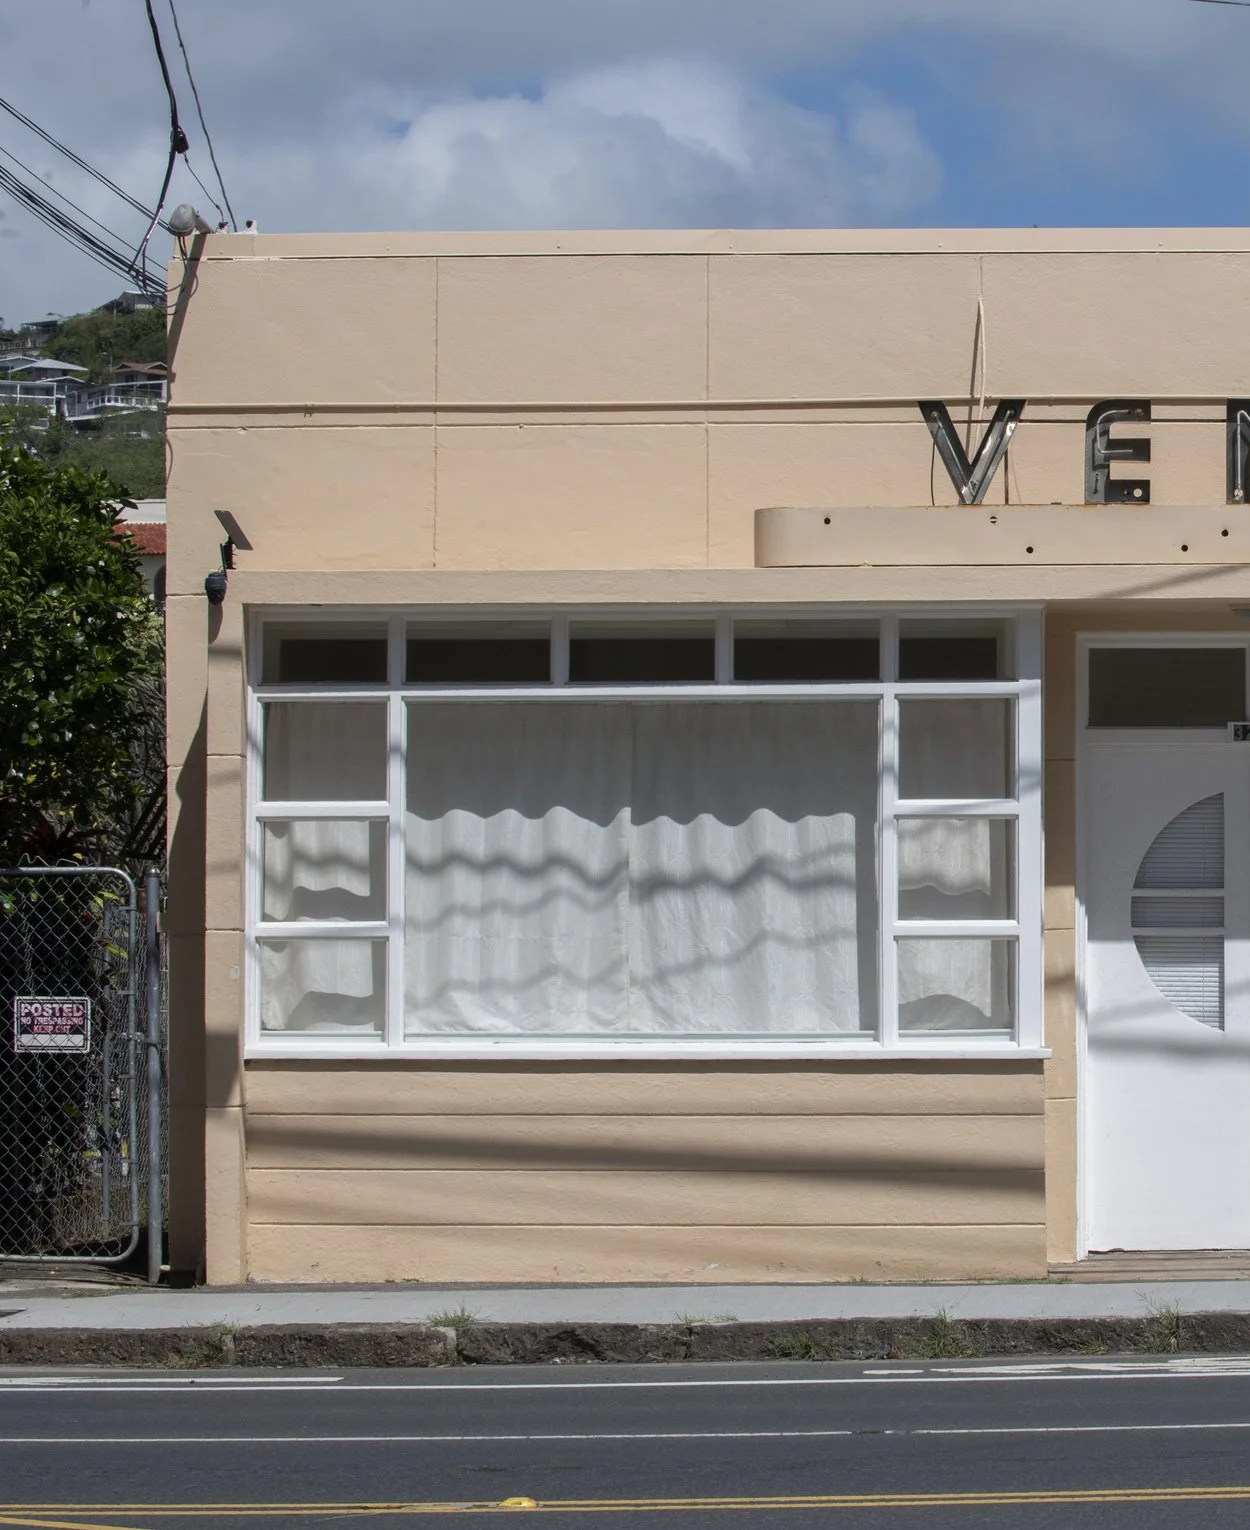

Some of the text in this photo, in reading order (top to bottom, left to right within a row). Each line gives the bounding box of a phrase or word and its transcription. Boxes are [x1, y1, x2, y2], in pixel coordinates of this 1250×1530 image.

[20, 1003, 84, 1016] POSTED
[20, 1016, 83, 1024] NO TRESPASSING
[33, 1025, 53, 1033] KEEP
